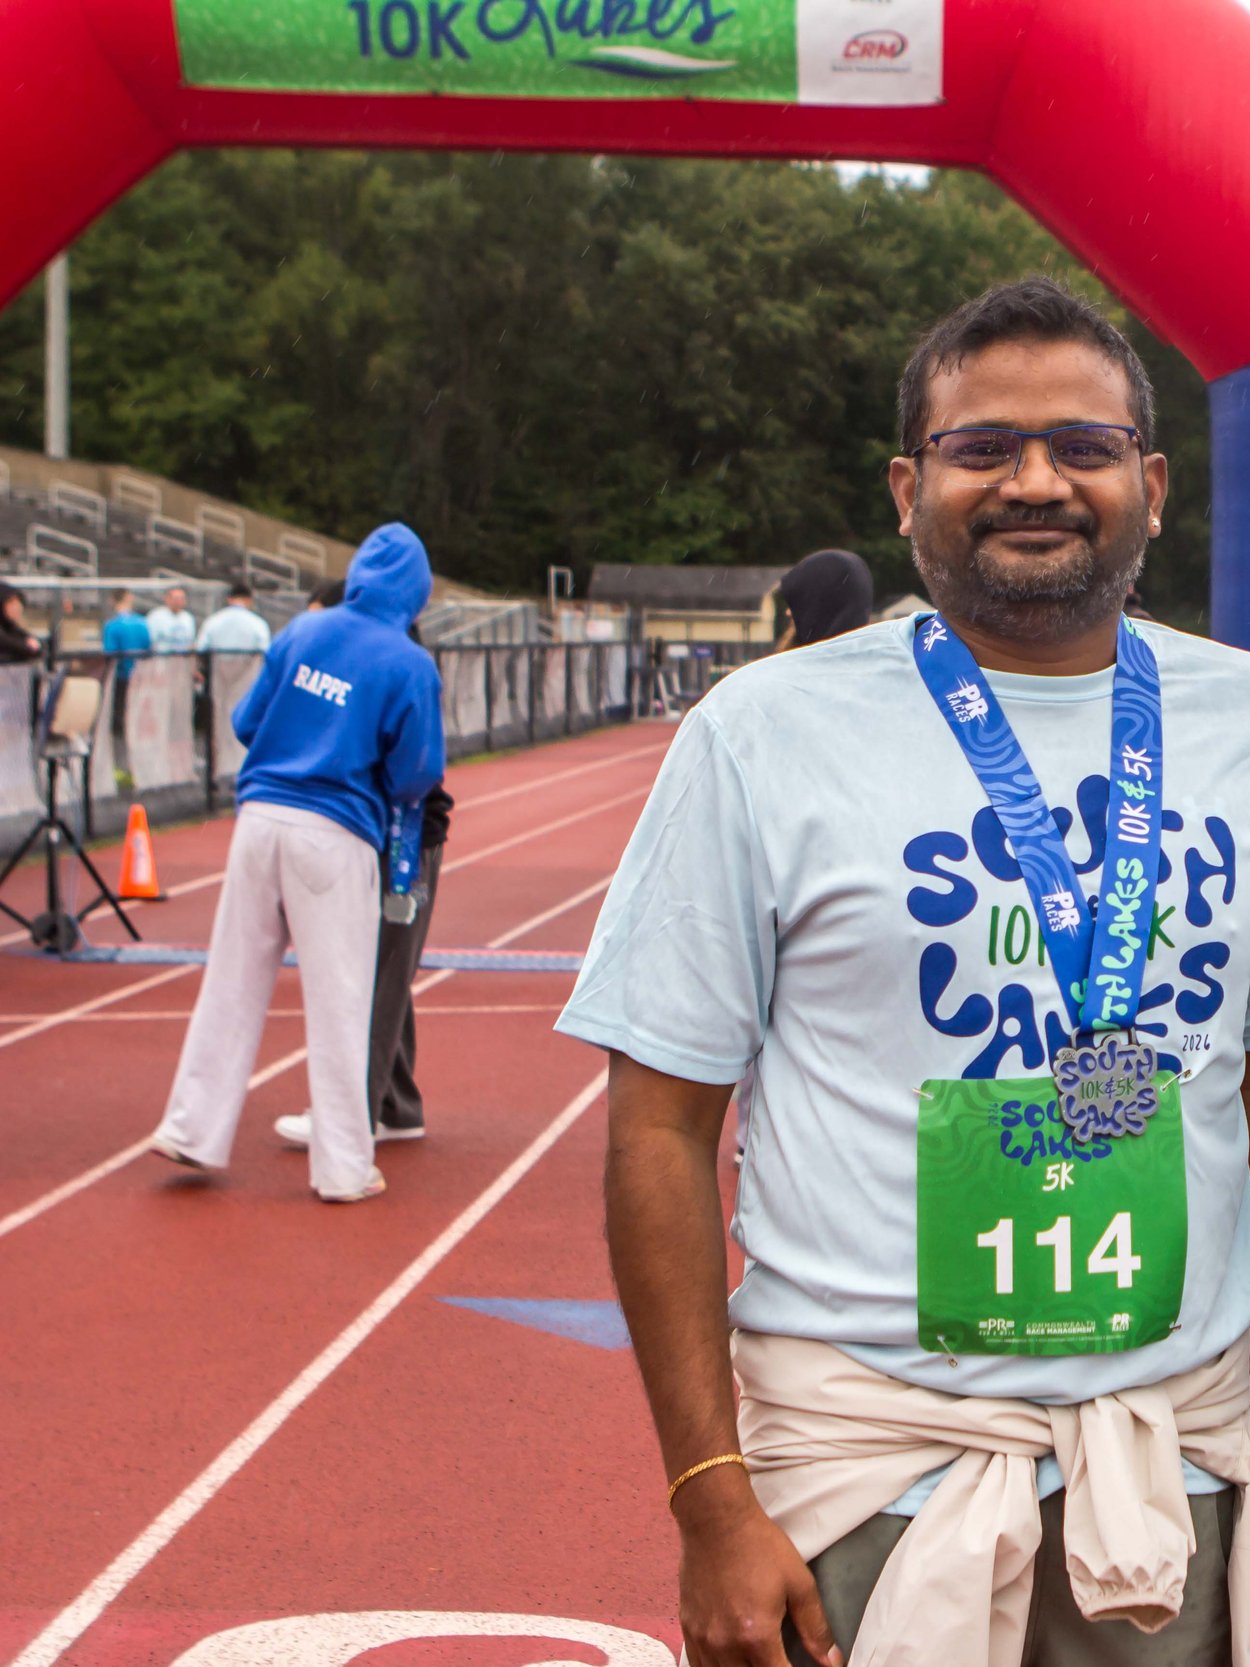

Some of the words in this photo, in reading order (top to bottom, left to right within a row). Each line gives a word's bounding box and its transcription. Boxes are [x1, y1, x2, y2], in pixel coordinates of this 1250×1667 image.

[348, 0, 471, 60] 10K
[294, 662, 352, 707] RAPPE
[945, 692, 971, 723] RACES
[1121, 744, 1153, 782] 5K
[1116, 779, 1155, 800] &
[1117, 800, 1152, 844] 10K
[1041, 894, 1062, 932] RACES
[1101, 857, 1149, 970] LAKES
[1182, 1034, 1211, 1052] 2026
[1060, 1040, 1153, 1089] SOUTH
[1065, 1087, 1156, 1137] LAKES
[1042, 1161, 1075, 1191] 5K
[977, 1211, 1142, 1295] 114
[1026, 1327, 1046, 1335] RACE
[1046, 1326, 1096, 1335] MANAGEMENT
